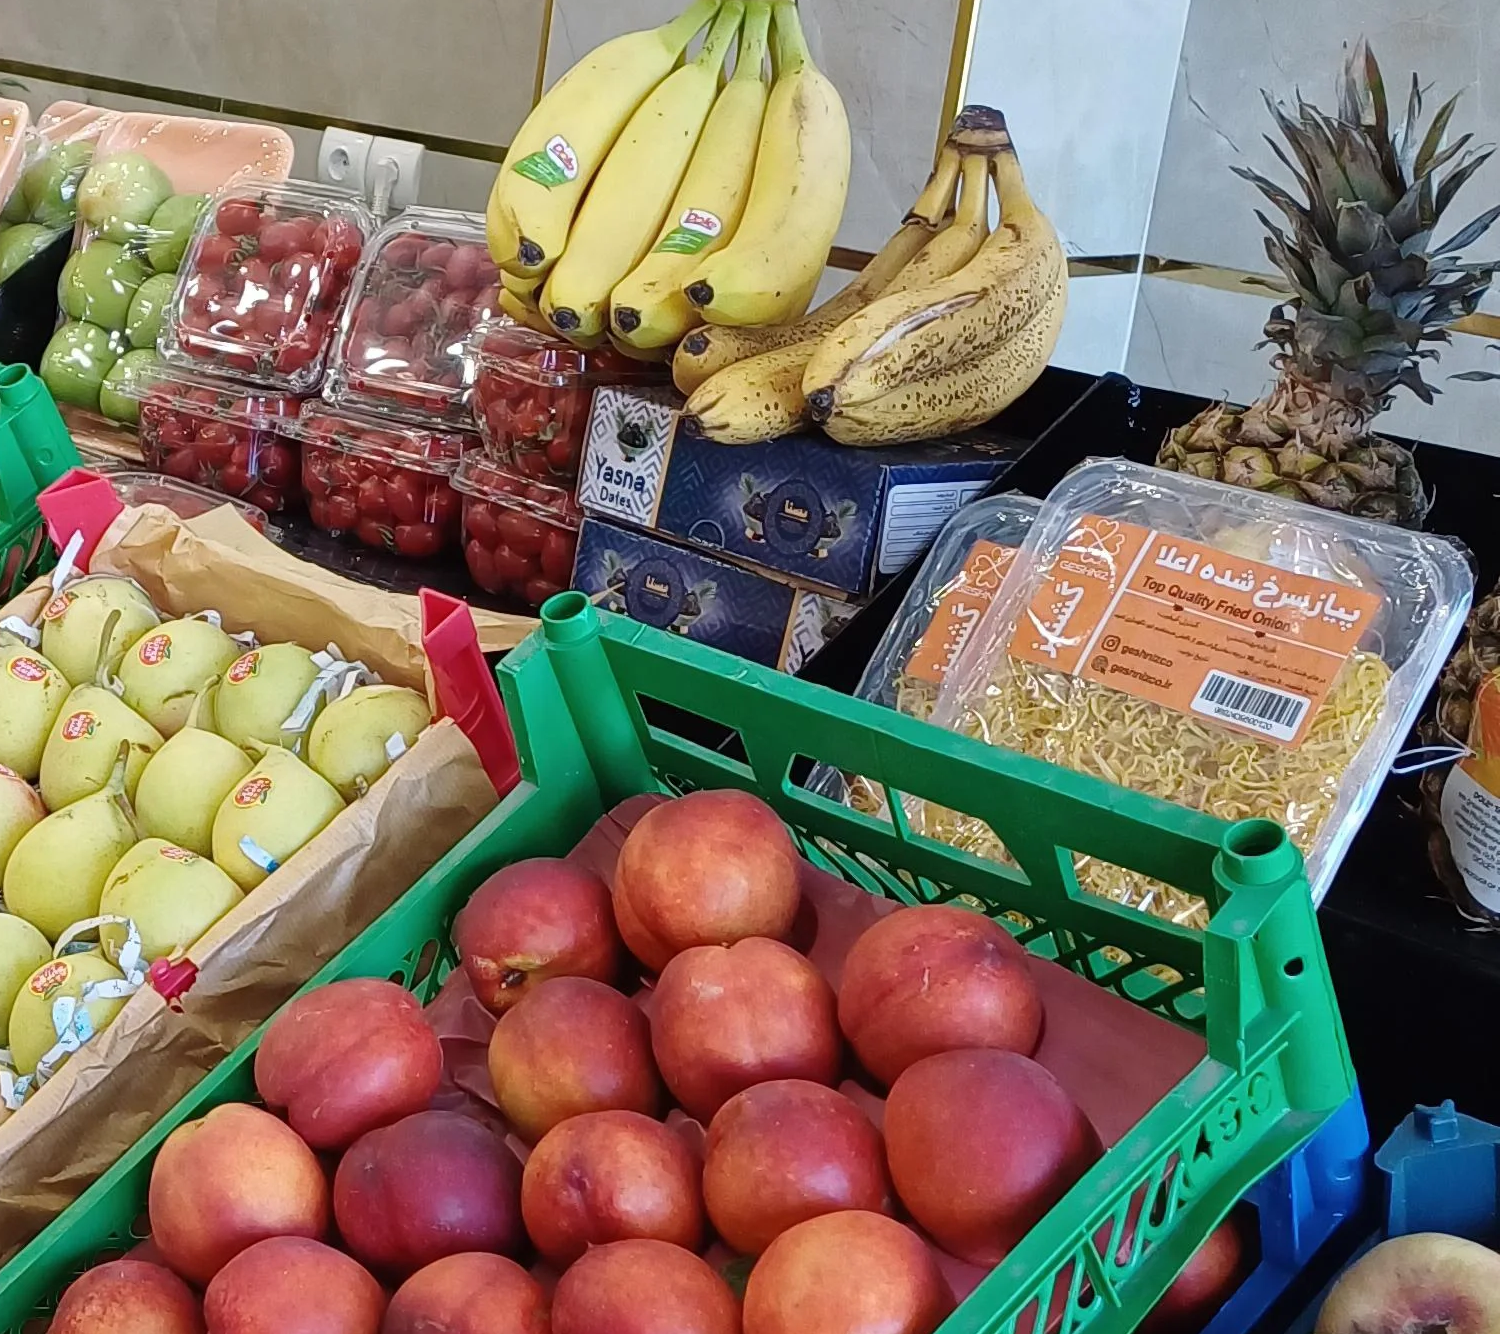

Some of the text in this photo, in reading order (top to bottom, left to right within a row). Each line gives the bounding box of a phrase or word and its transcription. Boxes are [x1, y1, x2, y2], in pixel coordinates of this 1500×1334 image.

[596, 455, 645, 493] Yasna
[600, 485, 631, 509] Dates
[1142, 575, 1166, 595] Top
[1168, 584, 1215, 613] Quality
[1215, 599, 1252, 621] Fried
[1154, 545, 1361, 631] پیاز سرخ شده اعلا
